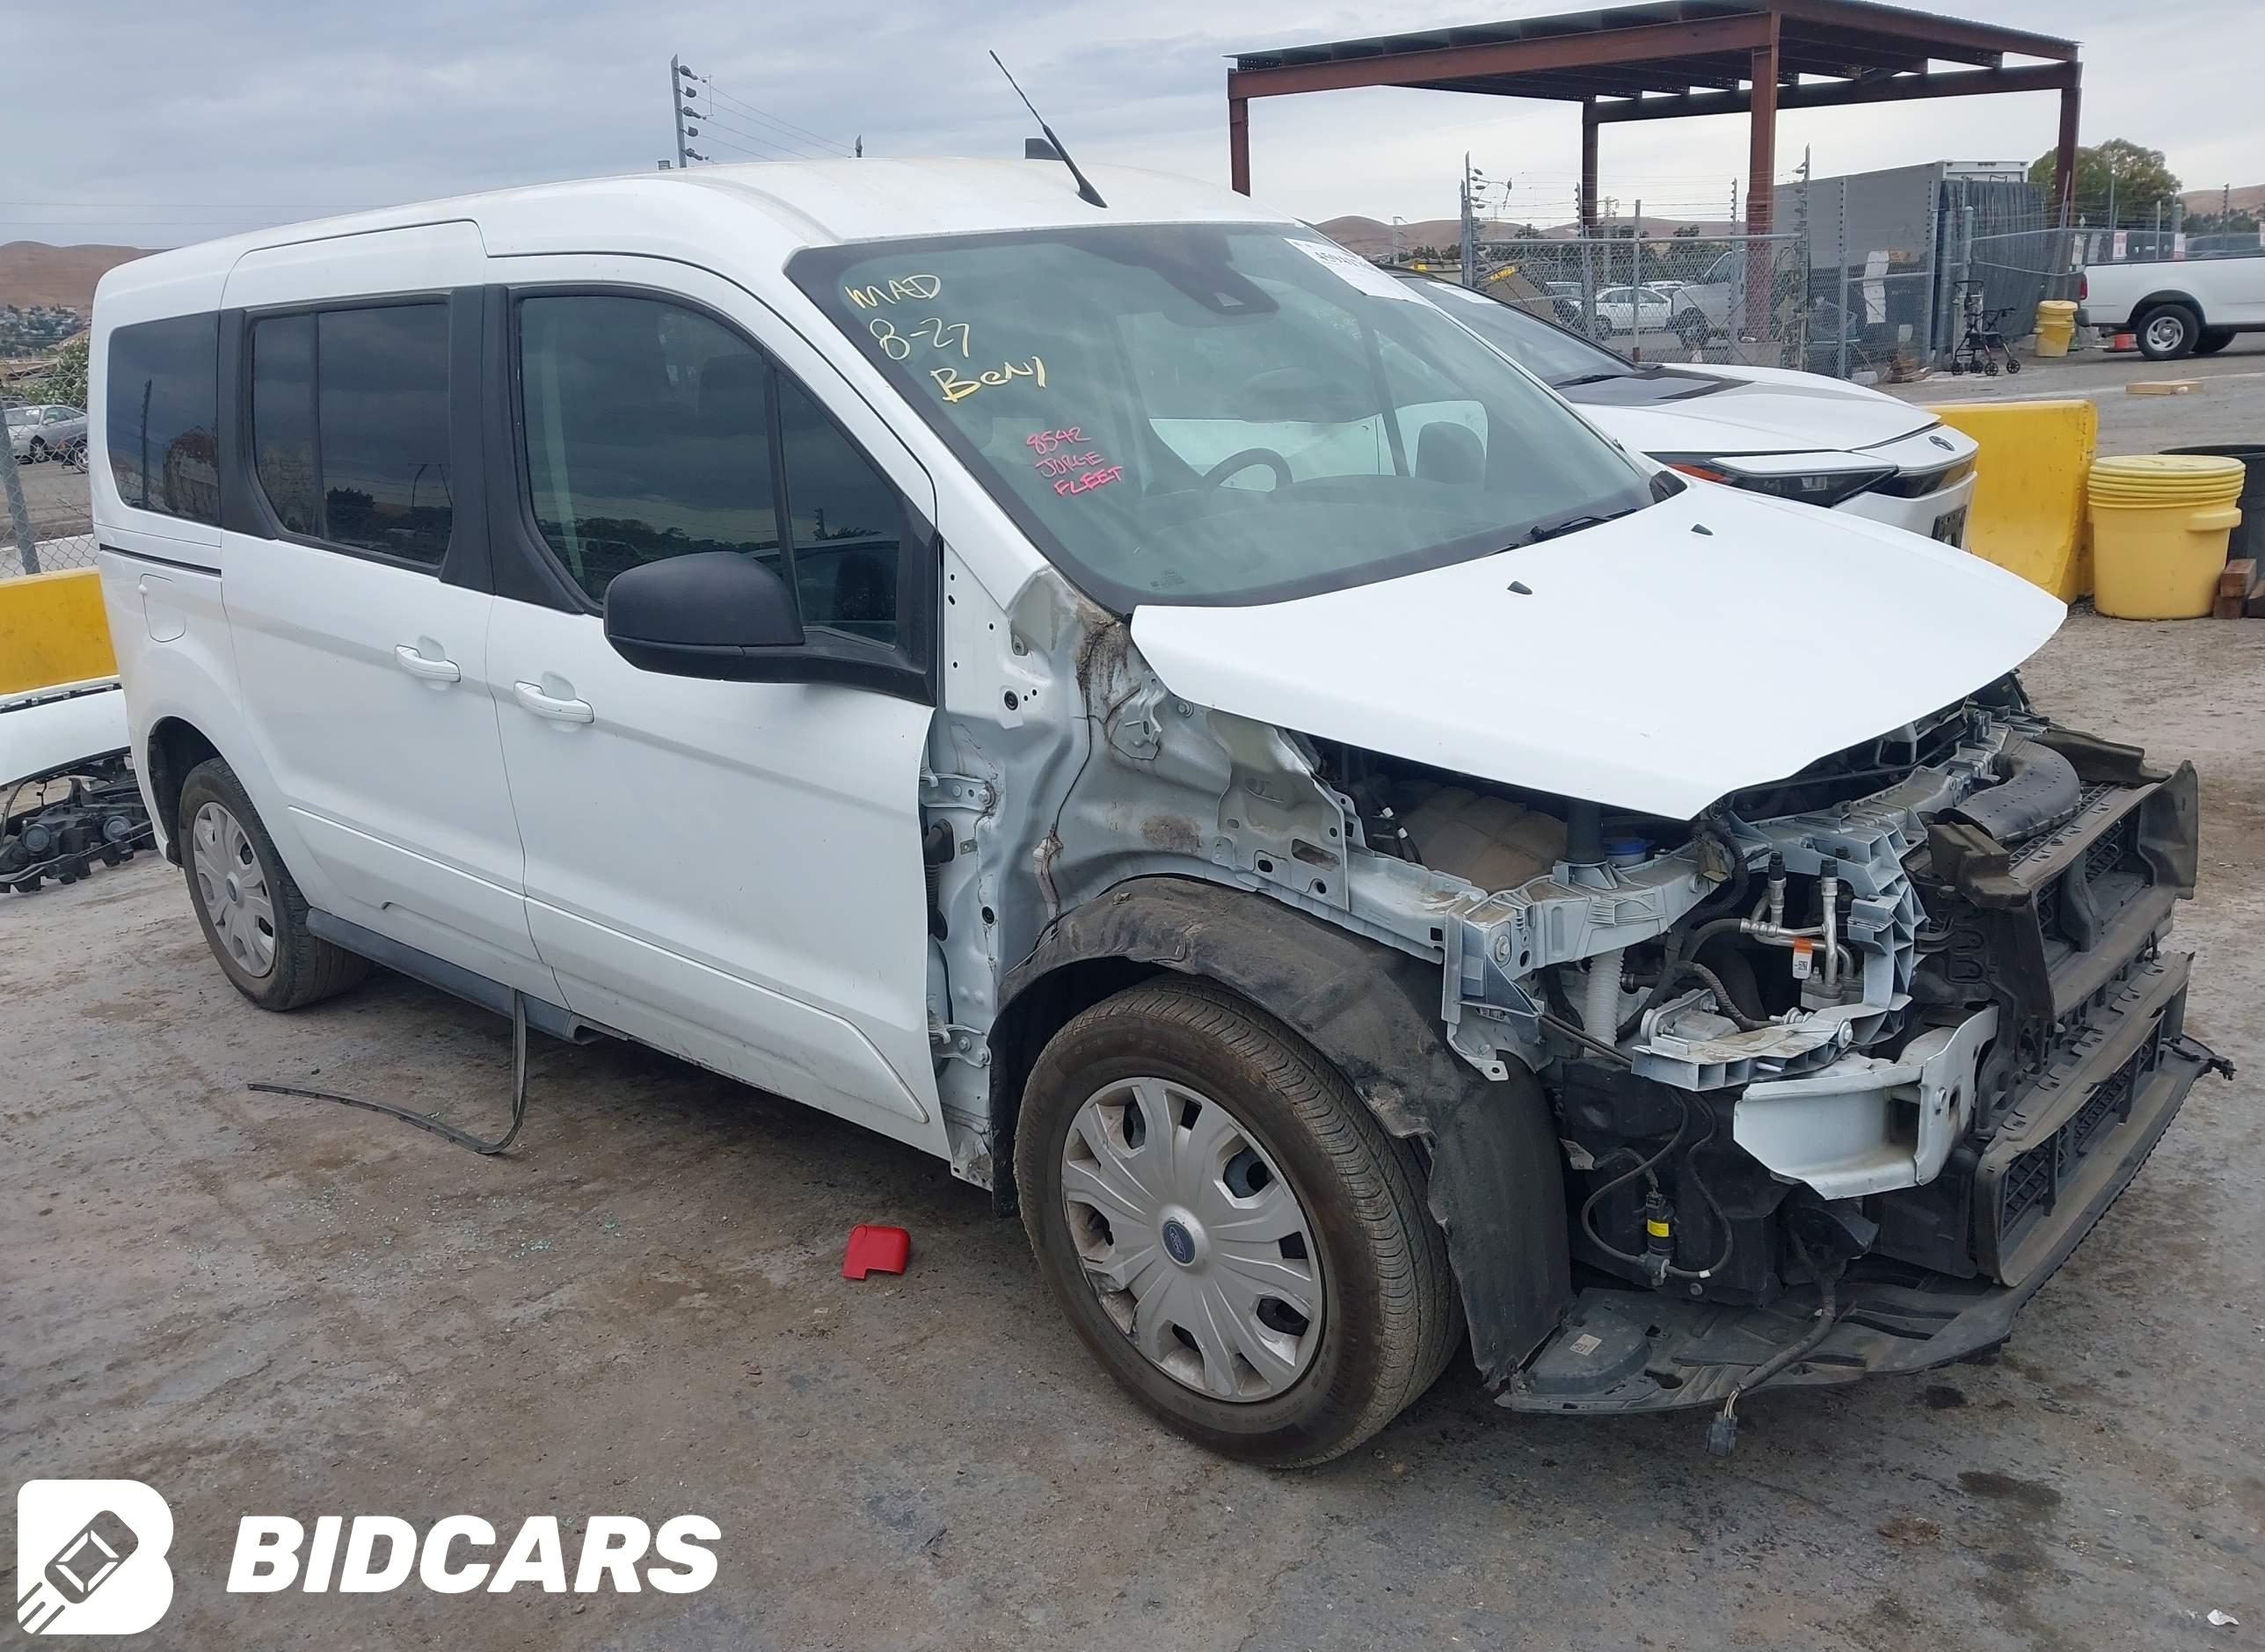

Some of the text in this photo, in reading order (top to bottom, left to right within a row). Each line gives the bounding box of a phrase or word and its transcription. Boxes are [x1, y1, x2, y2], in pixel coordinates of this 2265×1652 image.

[845, 274, 941, 309] MAD
[869, 317, 969, 360] 8-27
[1027, 426, 1091, 455] 8542
[1053, 466, 1124, 496] FLEET
